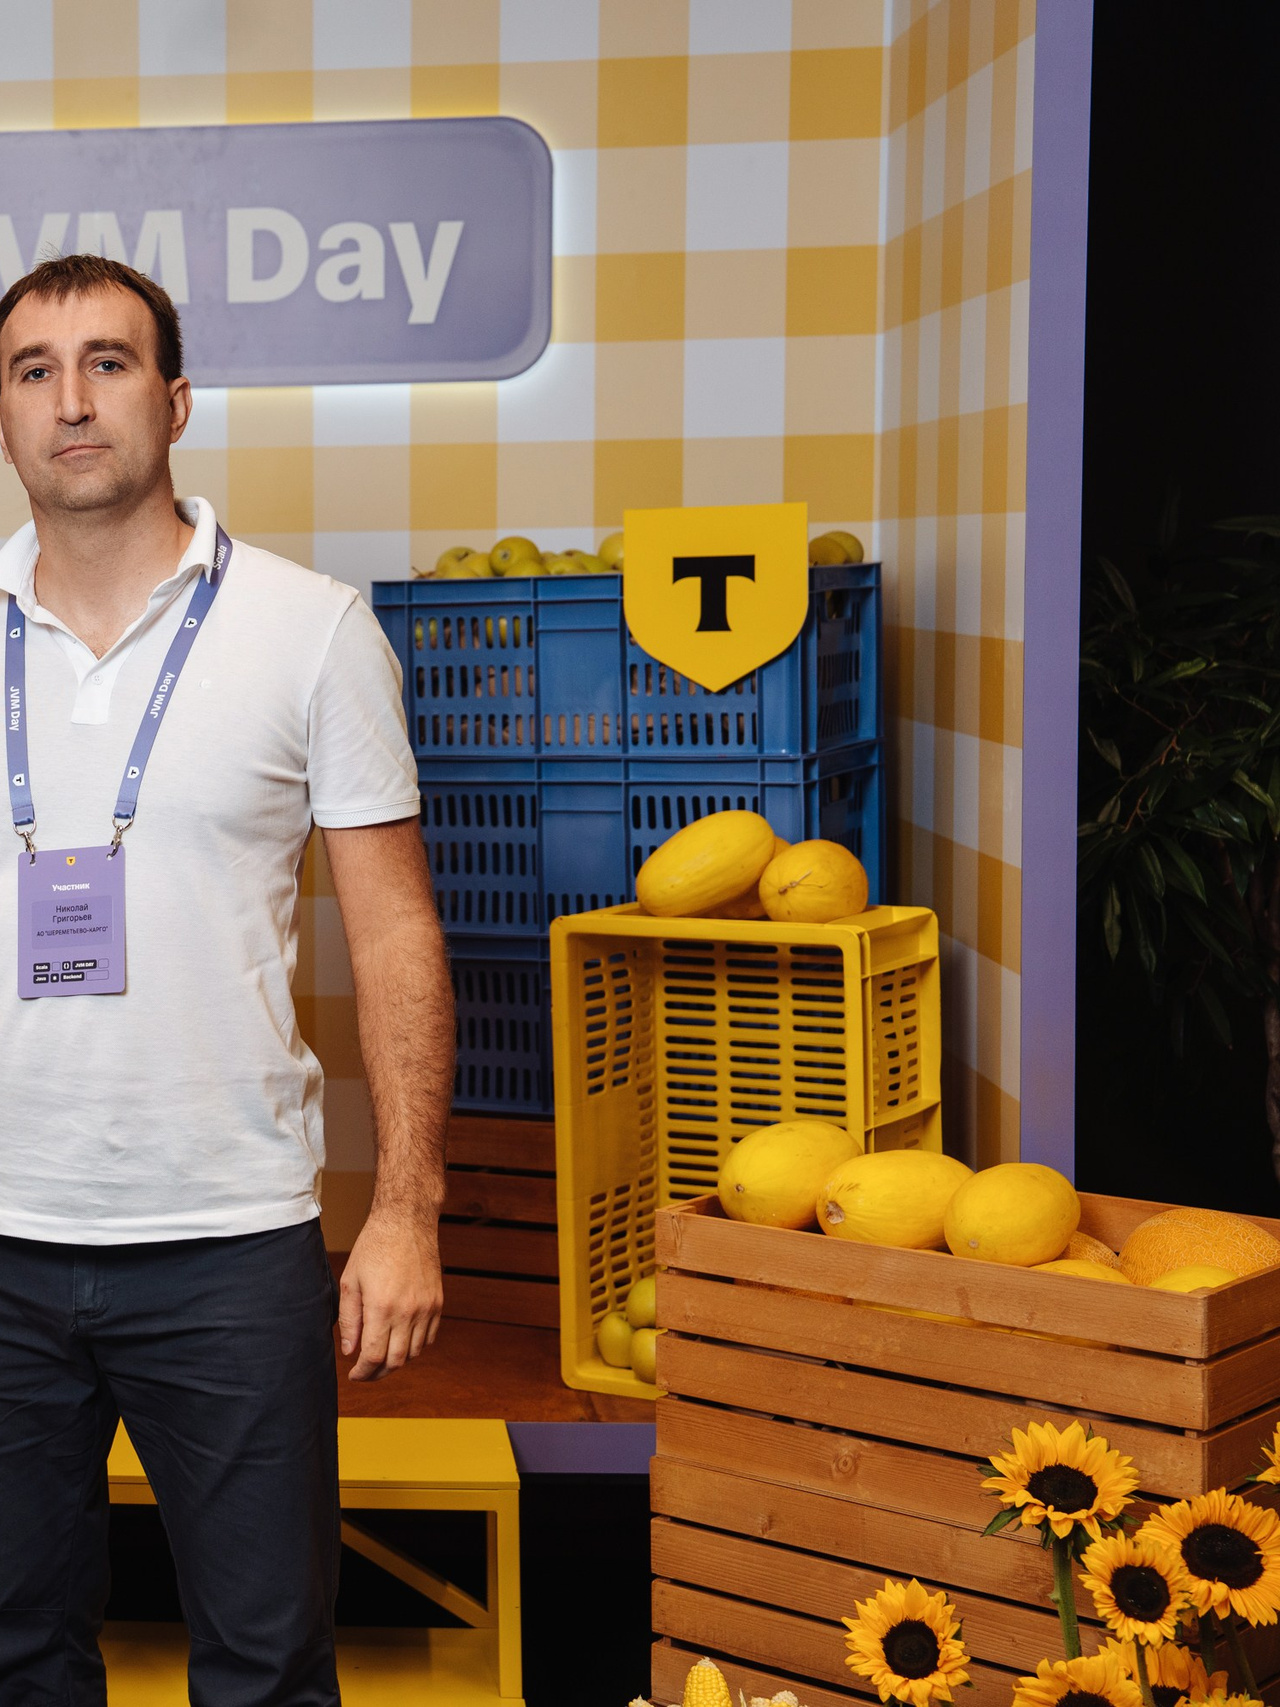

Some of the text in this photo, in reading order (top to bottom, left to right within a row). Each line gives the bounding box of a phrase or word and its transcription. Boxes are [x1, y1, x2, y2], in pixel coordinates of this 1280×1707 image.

[226, 207, 464, 325] Day
[213, 544, 227, 570] Scala
[672, 554, 756, 633] T
[8, 685, 21, 731] JVM Day
[150, 671, 176, 719] JVM Day
[51, 883, 91, 892] Участник
[52, 914, 92, 924] Григорьев
[55, 903, 89, 913] Николай
